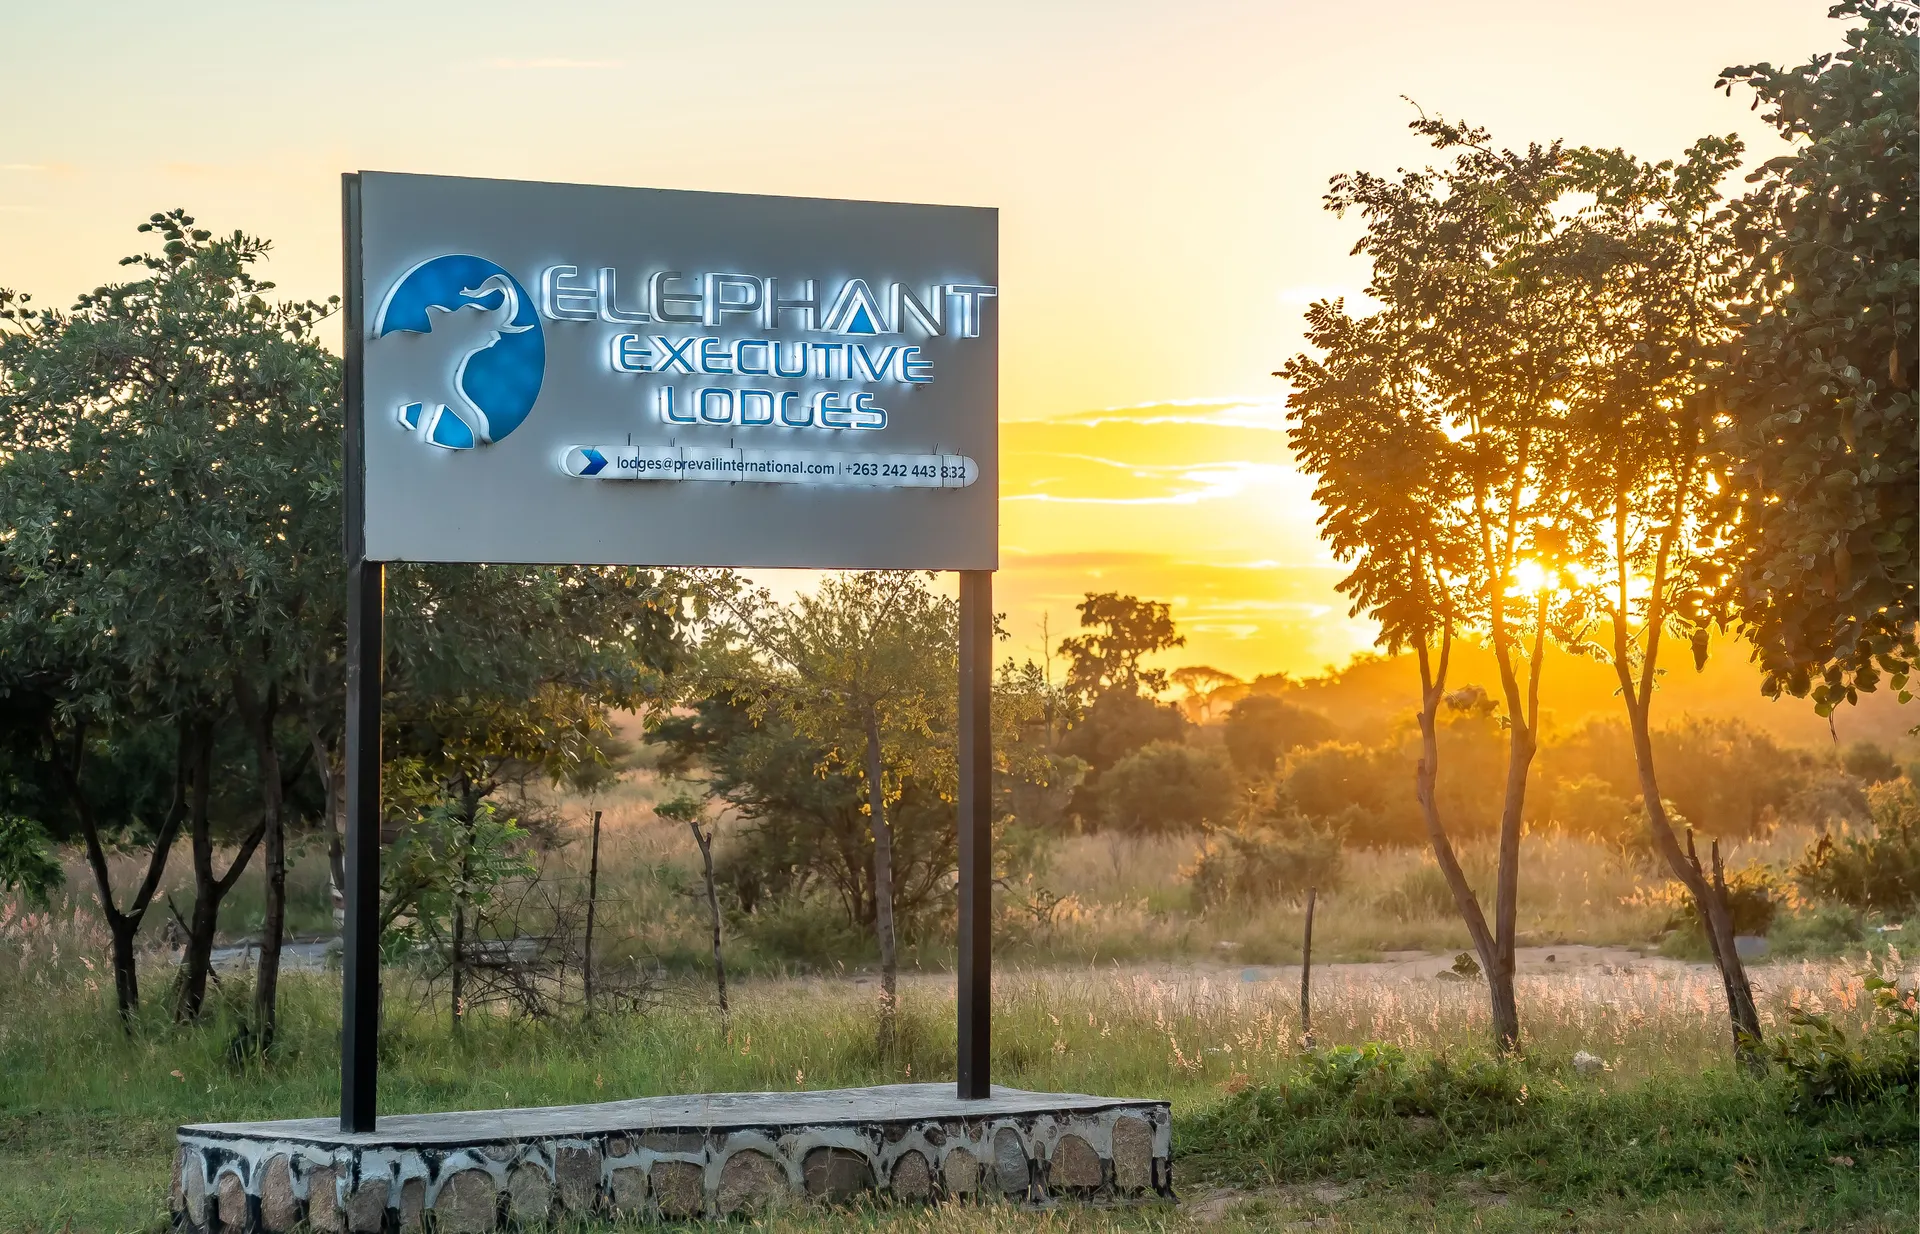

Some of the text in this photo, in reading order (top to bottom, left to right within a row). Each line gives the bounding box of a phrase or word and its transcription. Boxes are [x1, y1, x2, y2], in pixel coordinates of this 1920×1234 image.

[540, 264, 998, 338] ELEPHANT
[612, 333, 935, 384] EXECUTIVE
[659, 385, 889, 430] LODGES
[616, 455, 835, 475] lodges@prevailinternational.com
[845, 463, 878, 476] +263
[882, 464, 907, 477] 242
[911, 465, 937, 478] 443
[940, 466, 966, 479] 832
